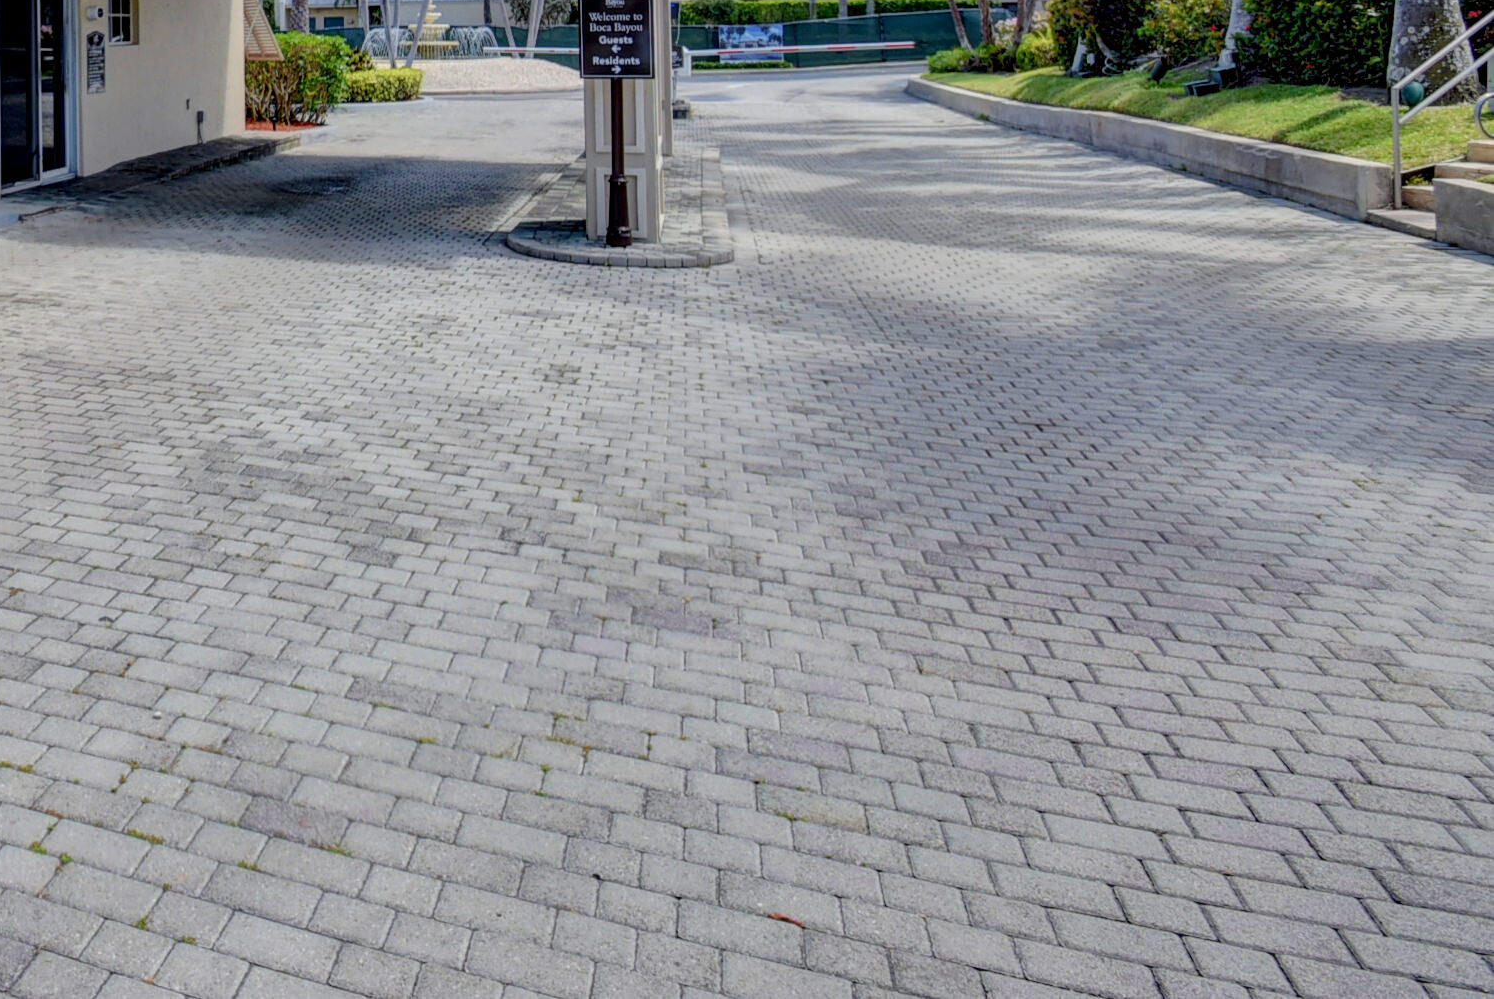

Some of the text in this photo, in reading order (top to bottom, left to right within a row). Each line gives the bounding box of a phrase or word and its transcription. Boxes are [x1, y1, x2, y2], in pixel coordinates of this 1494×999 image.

[588, 12, 643, 22] Welcome to
[589, 22, 643, 34] Boca Bayou
[598, 35, 633, 45] Guests
[592, 56, 641, 66] Residents
